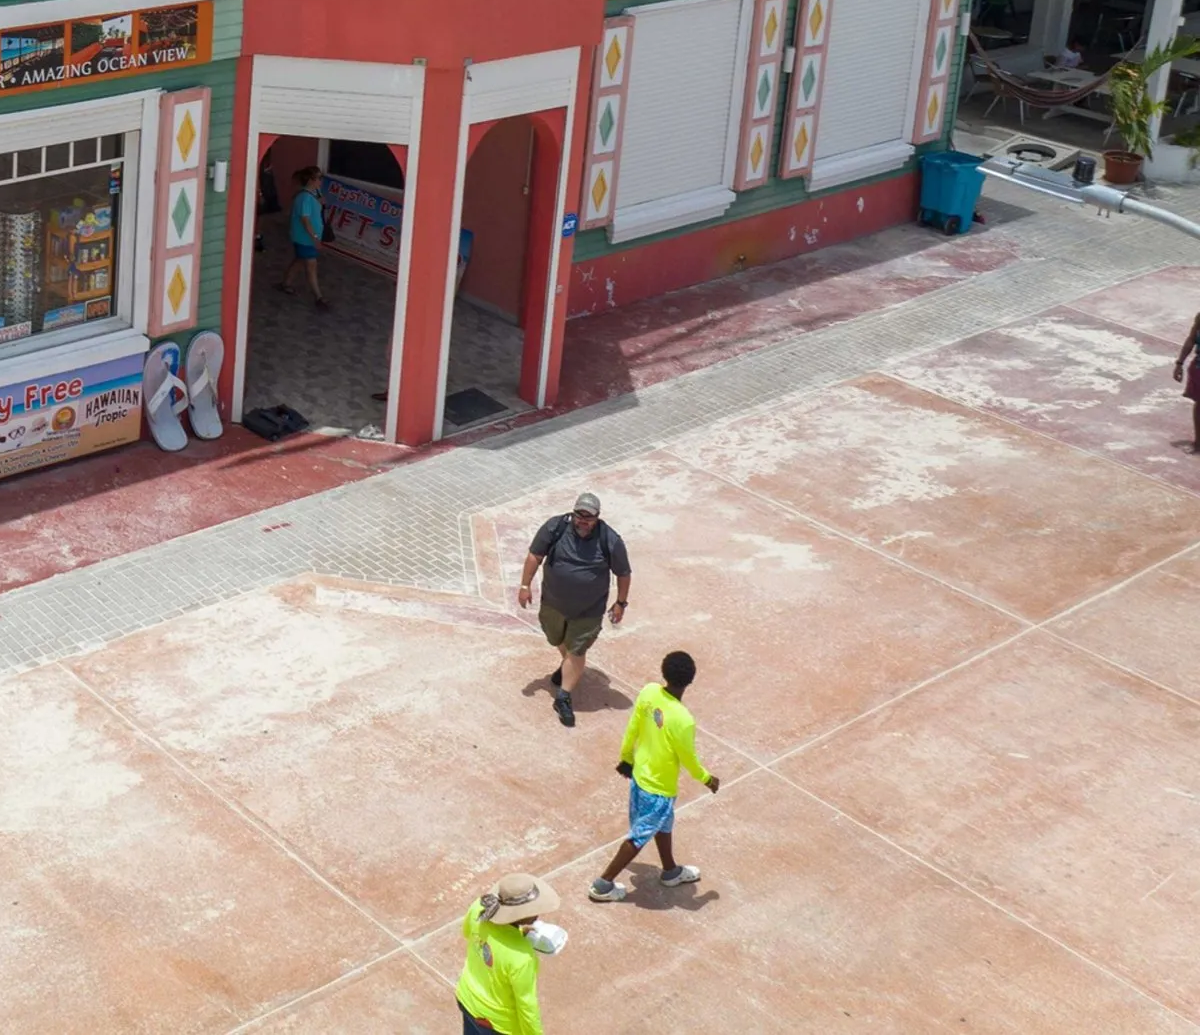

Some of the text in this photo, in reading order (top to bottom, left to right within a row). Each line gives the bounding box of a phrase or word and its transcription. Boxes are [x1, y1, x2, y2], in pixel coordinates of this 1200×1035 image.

[21, 62, 93, 86] AMAZING
[97, 53, 148, 73] OCEAN
[152, 47, 189, 62] VIEW
[329, 181, 376, 208] Mystic
[24, 377, 84, 412] Free
[86, 389, 140, 419] HAWAIIAN
[94, 406, 128, 428] Tropic
